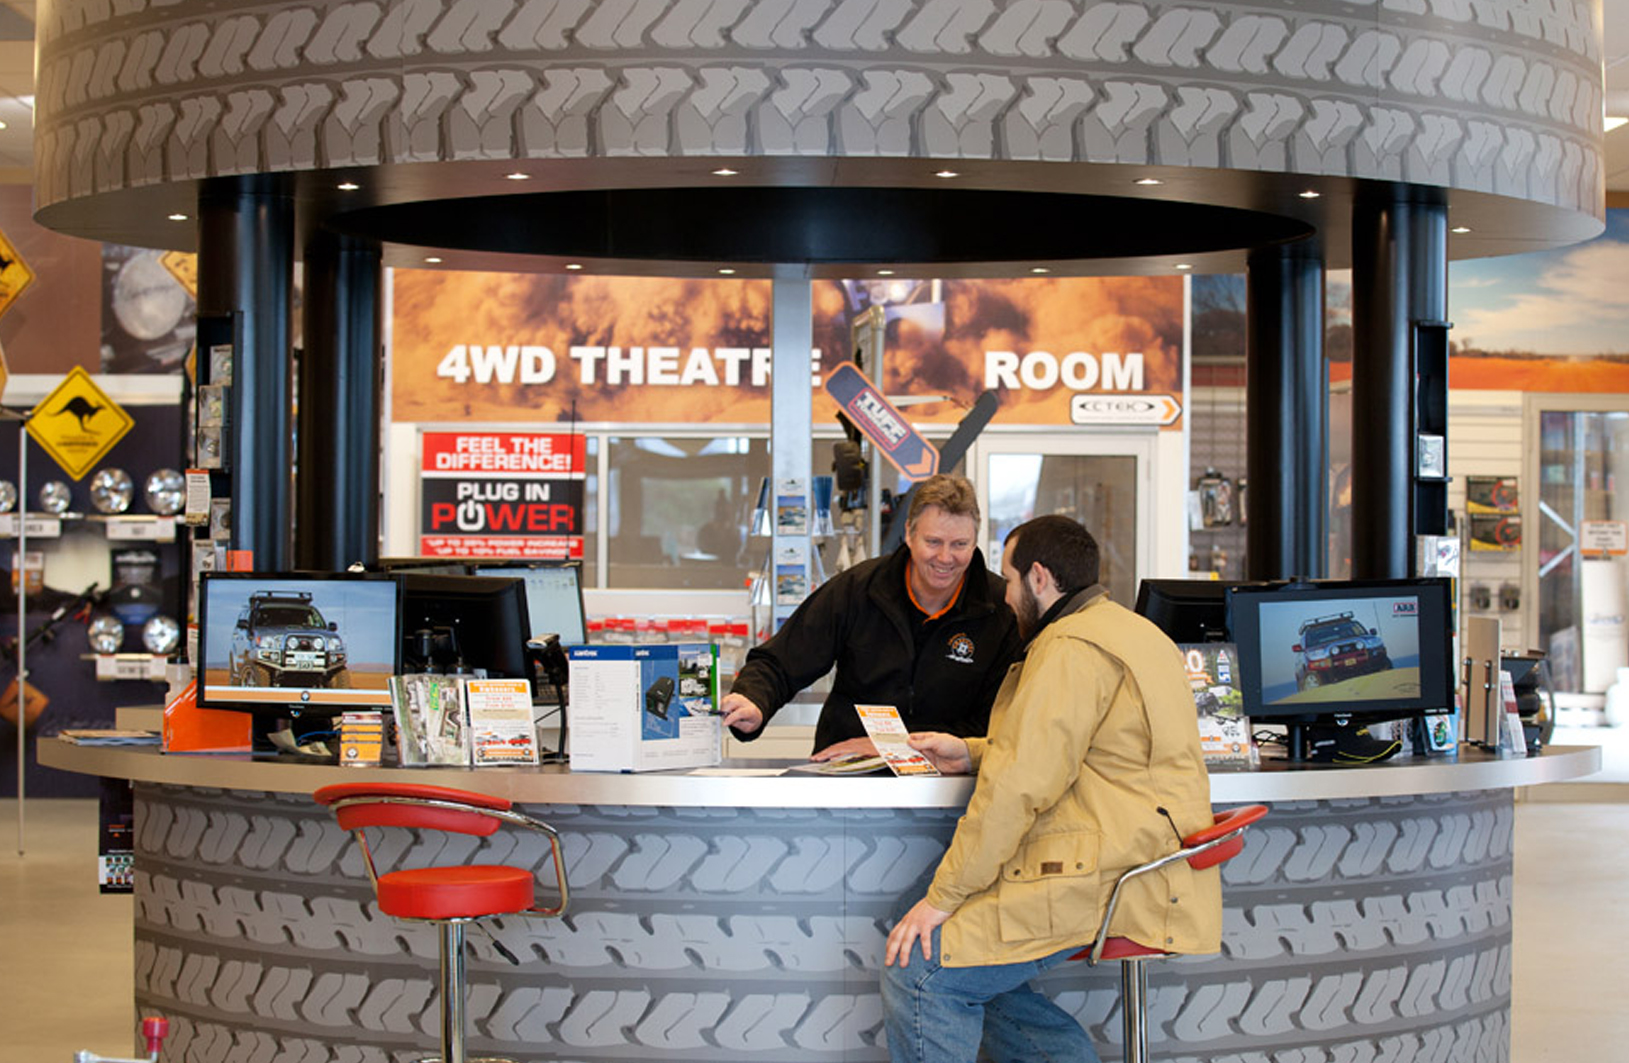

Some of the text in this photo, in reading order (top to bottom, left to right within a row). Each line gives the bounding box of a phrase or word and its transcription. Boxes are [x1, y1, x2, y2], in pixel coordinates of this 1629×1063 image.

[437, 345, 1144, 390] 4WD THEATR ROOM
[857, 391, 908, 438] TUFF
[456, 437, 553, 454] FEEL THE
[436, 453, 572, 470] DIFFERENCE!
[457, 482, 550, 501] PLUG IN
[431, 500, 575, 532] POWER
